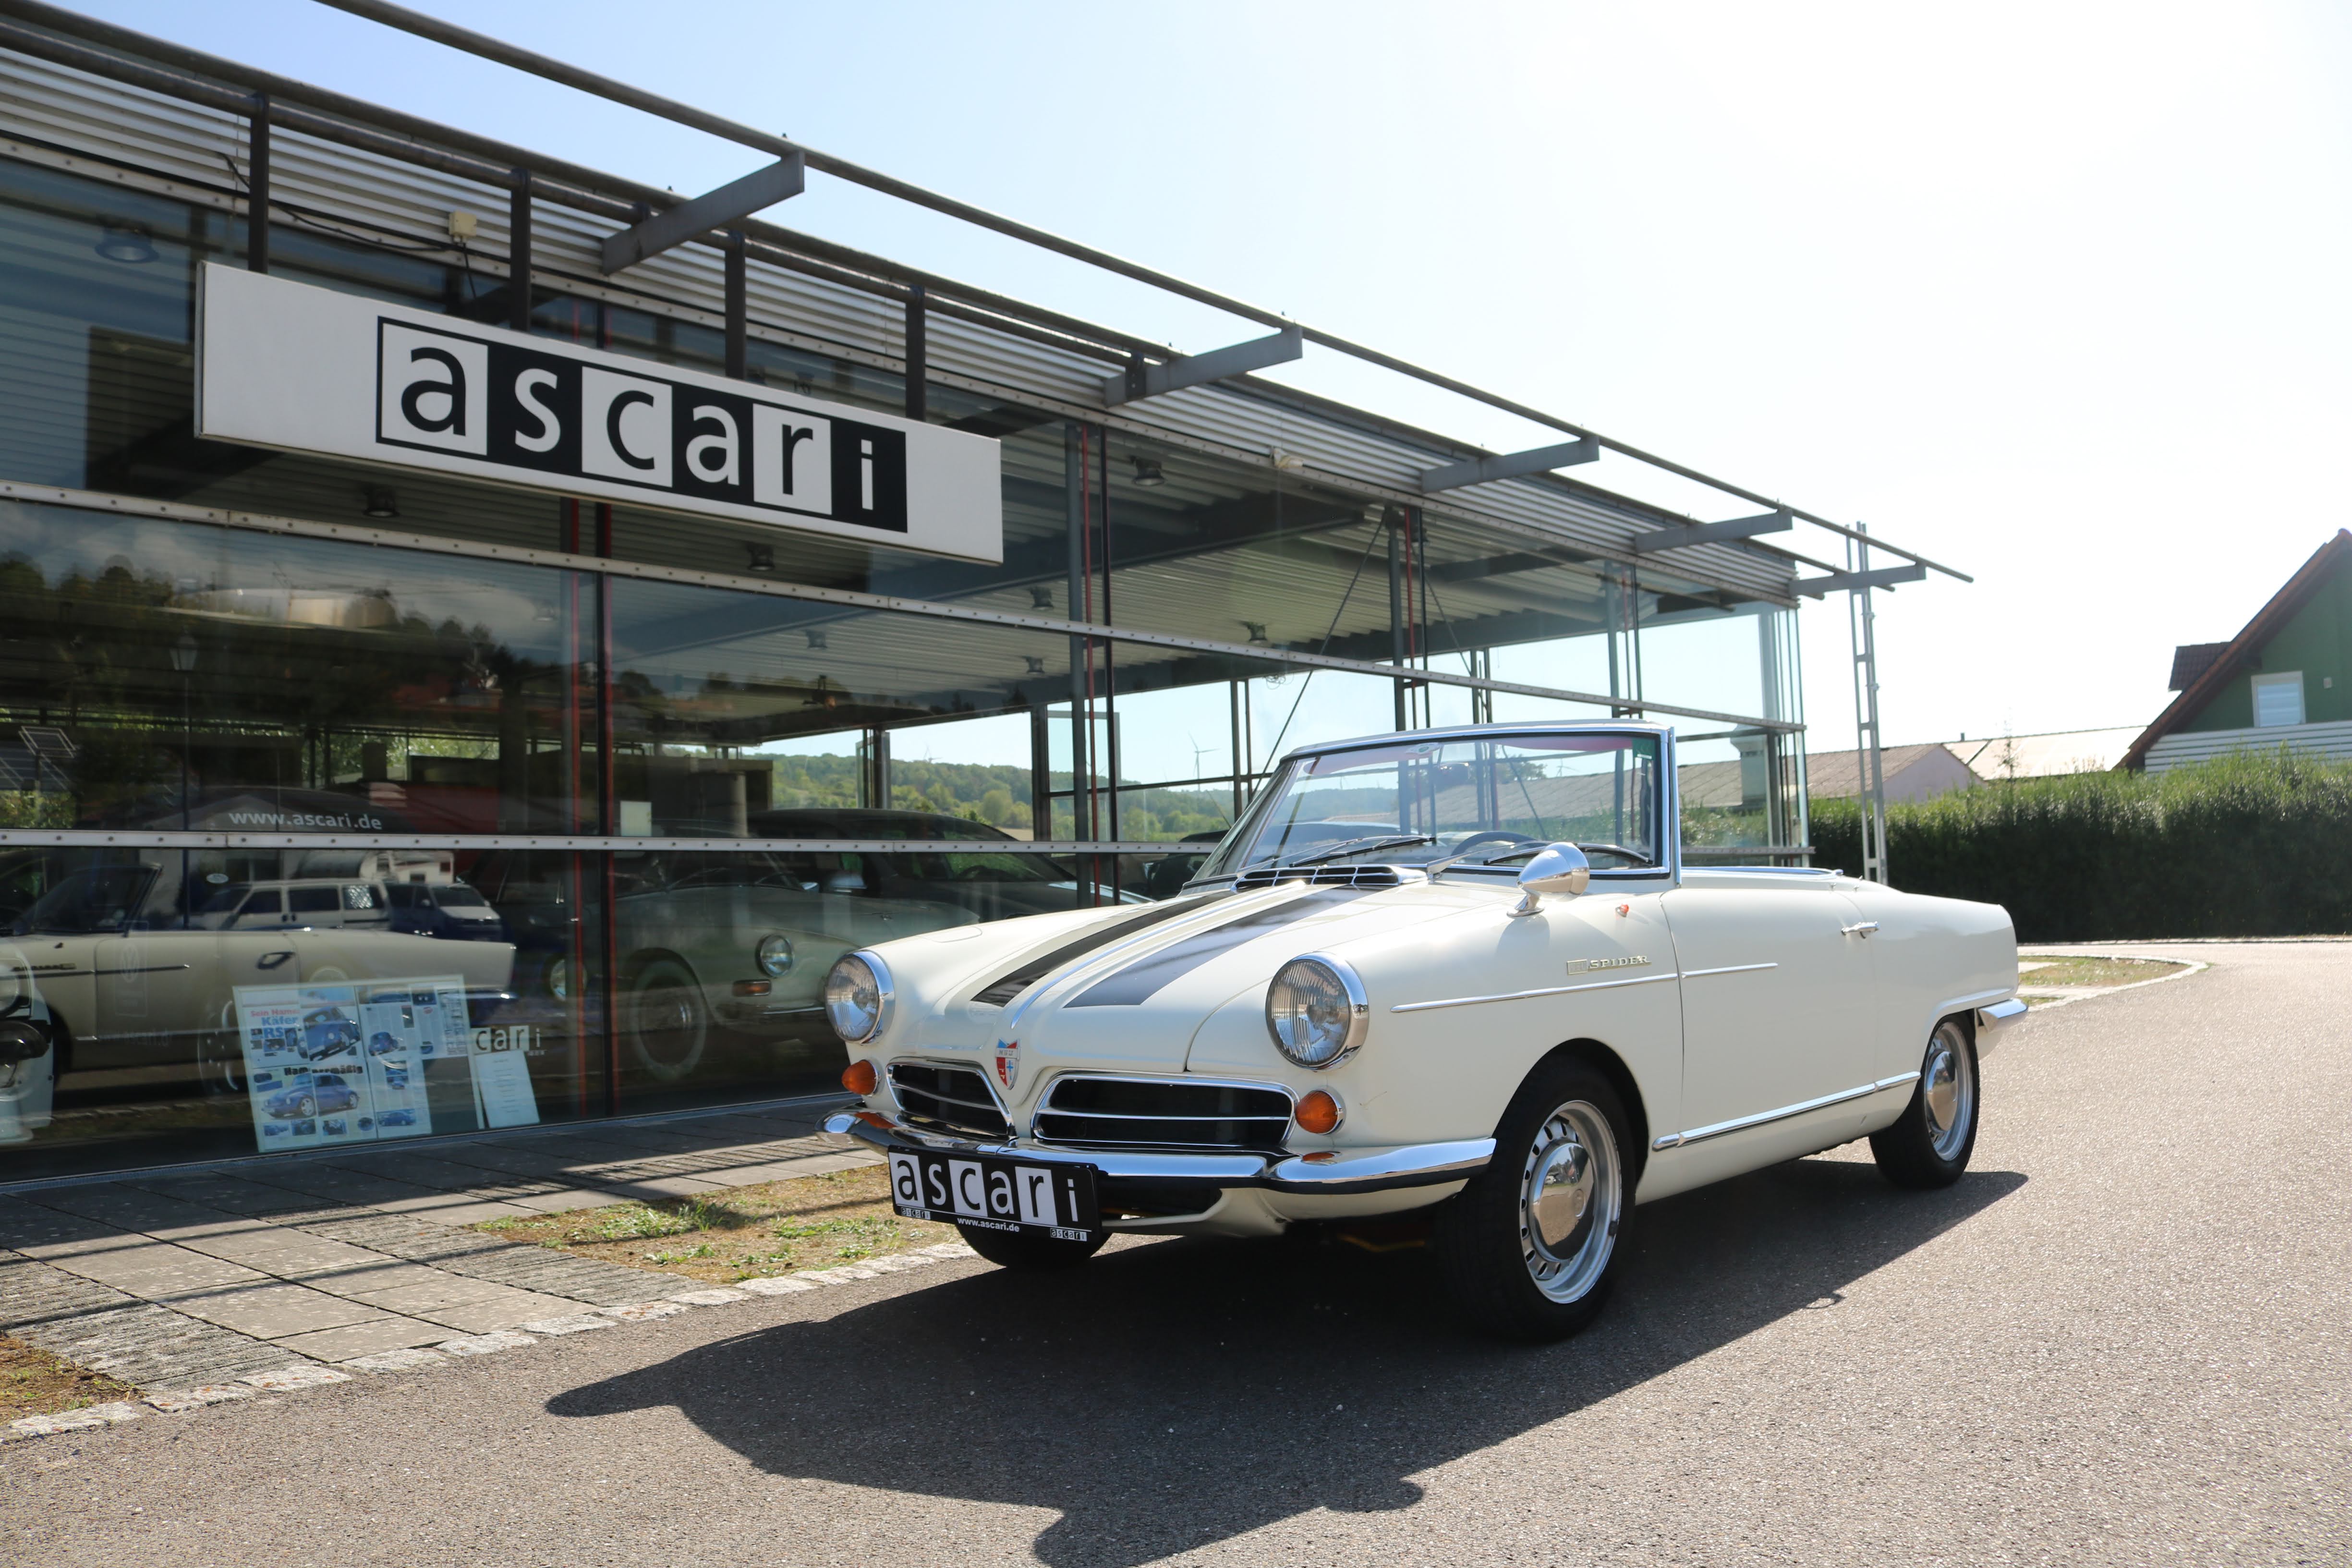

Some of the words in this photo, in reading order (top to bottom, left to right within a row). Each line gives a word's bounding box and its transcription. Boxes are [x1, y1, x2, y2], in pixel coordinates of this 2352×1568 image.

[400, 346, 874, 511] ascari
[229, 813, 382, 830] www.ascari.de
[1589, 955, 1649, 969] SPIDER
[261, 1016, 298, 1026] Käfer
[263, 1027, 285, 1038] RS
[897, 1160, 1079, 1222] ascari
[902, 1208, 930, 1219] ascari
[957, 1218, 1019, 1232] www.ascari.de
[1051, 1229, 1085, 1240] ascari
